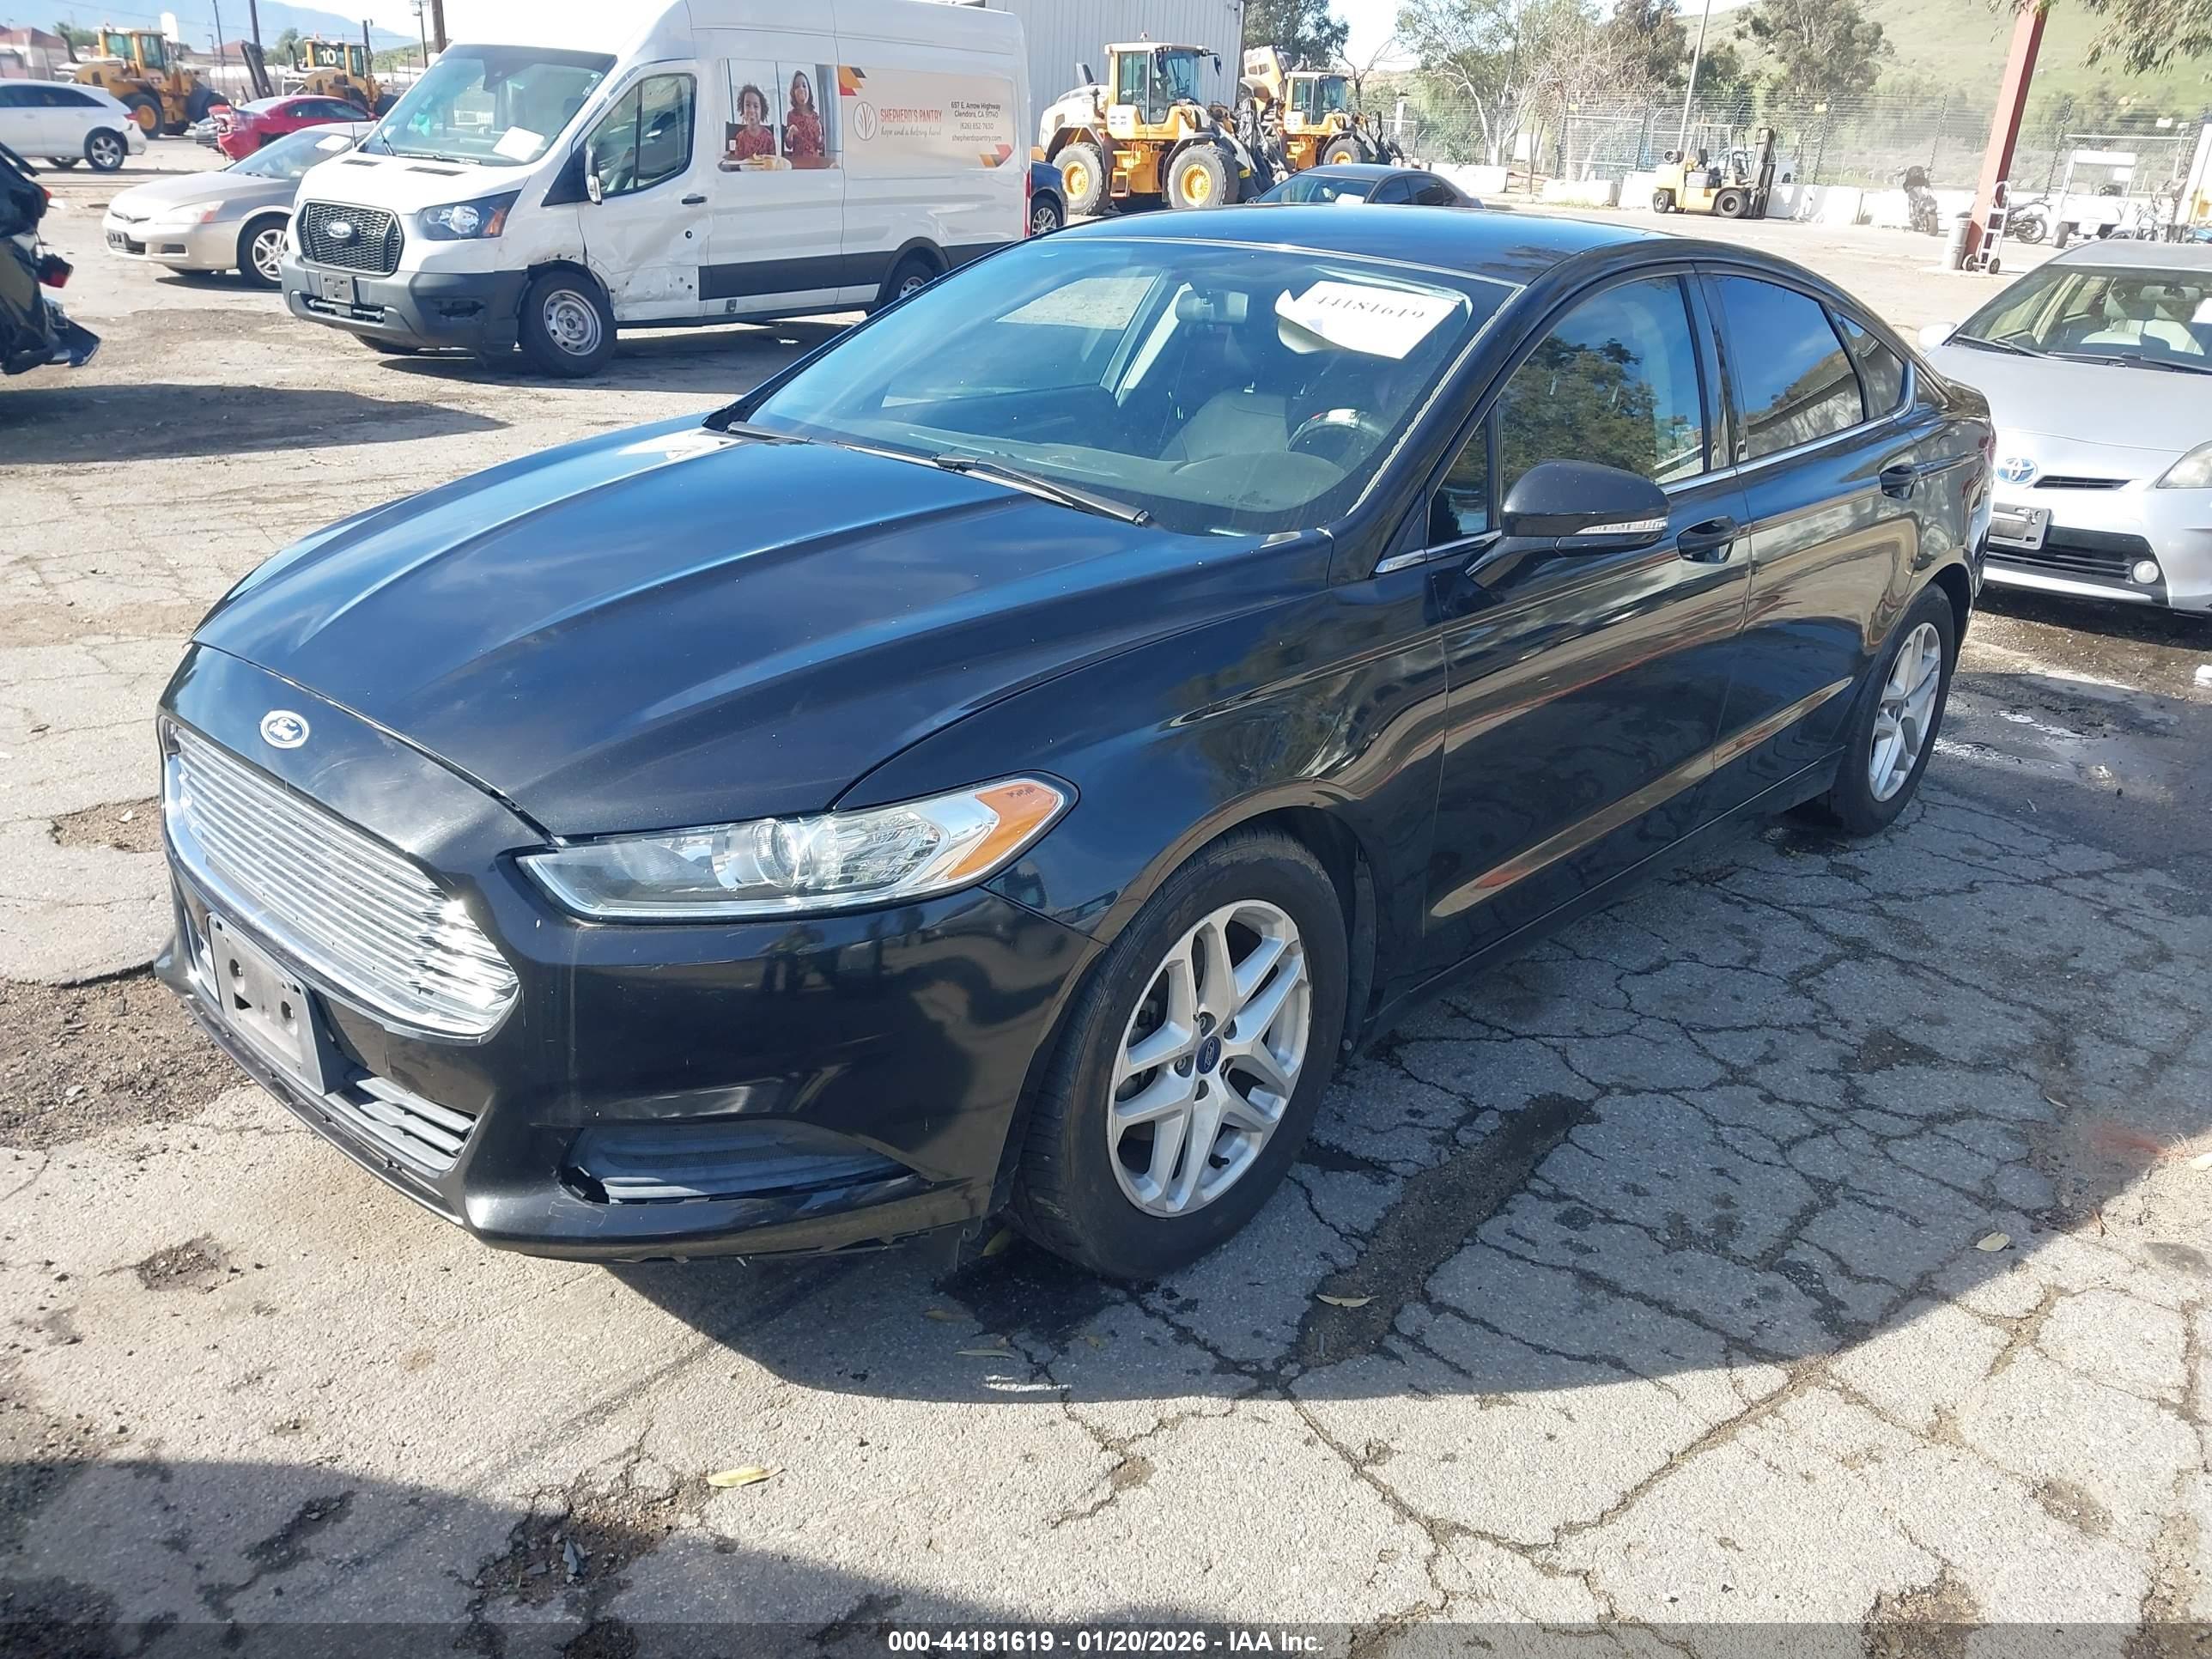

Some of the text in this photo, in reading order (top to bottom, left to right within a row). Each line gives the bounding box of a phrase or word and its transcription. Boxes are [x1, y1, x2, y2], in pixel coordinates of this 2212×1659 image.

[319, 49, 337, 64] 10
[981, 102, 1000, 111] Highway
[880, 108, 943, 123] SHEPHERD'S PANTRY
